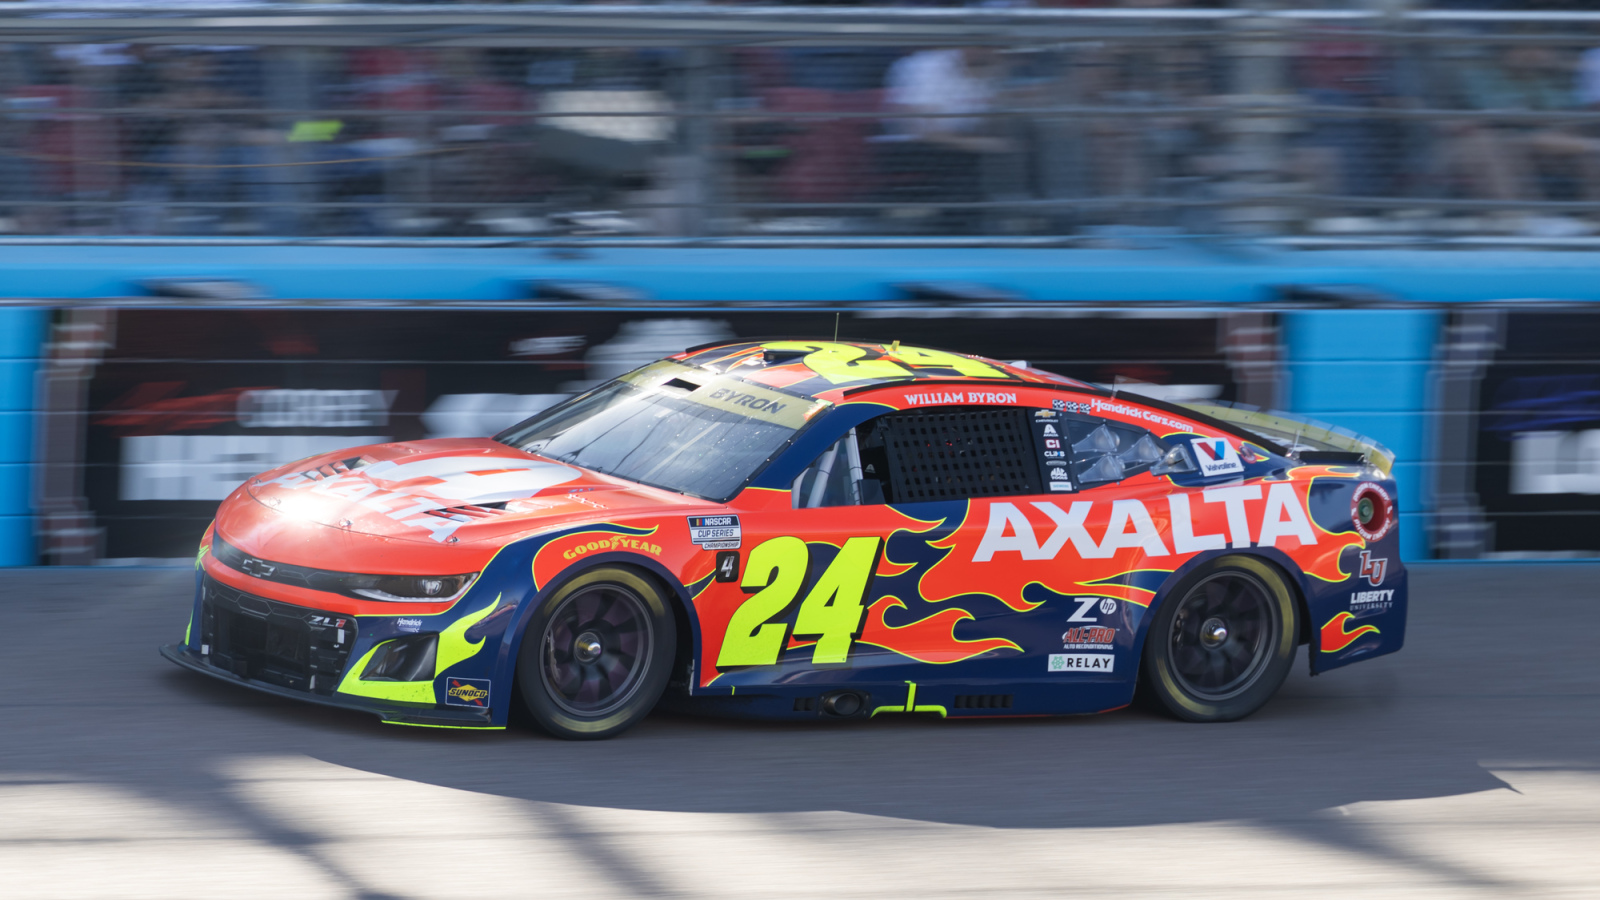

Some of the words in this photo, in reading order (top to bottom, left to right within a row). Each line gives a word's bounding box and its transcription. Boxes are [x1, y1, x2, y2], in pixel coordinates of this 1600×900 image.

[709, 388, 787, 414] BYRON
[904, 392, 964, 405] WILLIAM
[968, 392, 1017, 404] BYRON
[1205, 462, 1237, 472] Valvoline
[704, 517, 732, 526] NASCAR
[971, 483, 1318, 563] AXALTA
[697, 529, 711, 538] CUP
[711, 528, 735, 537] SERIES
[563, 536, 663, 560] GOODYEAR
[721, 555, 735, 577] 4
[1359, 550, 1388, 587] LU
[715, 536, 884, 672] 24
[1350, 589, 1395, 604] LIBERTY
[1066, 597, 1100, 622] Z
[309, 615, 347, 628] ZL1
[1066, 657, 1111, 669] RELAY
[449, 688, 487, 698] SUNOCO
